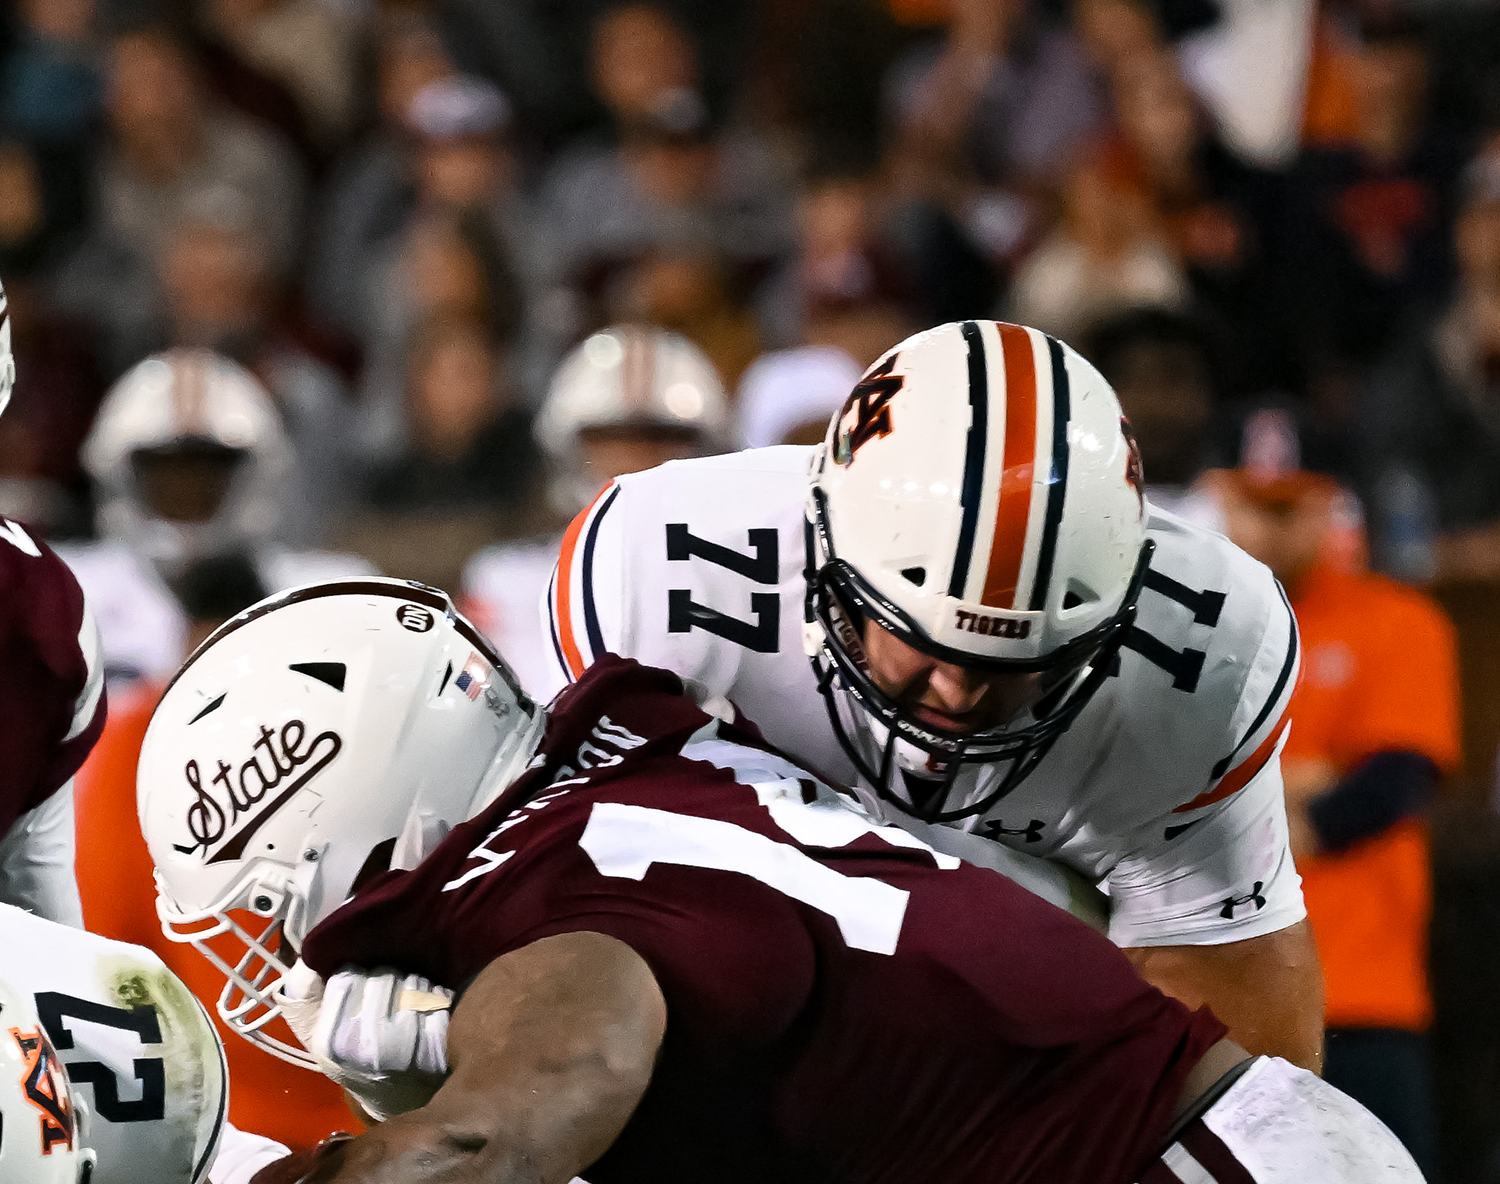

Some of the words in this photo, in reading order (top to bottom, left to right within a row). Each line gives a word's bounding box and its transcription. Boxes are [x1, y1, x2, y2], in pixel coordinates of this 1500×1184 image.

[665, 523, 780, 654] 77
[955, 609, 1032, 640] TIGERS
[186, 719, 320, 858] State
[34, 990, 165, 1123] 27
